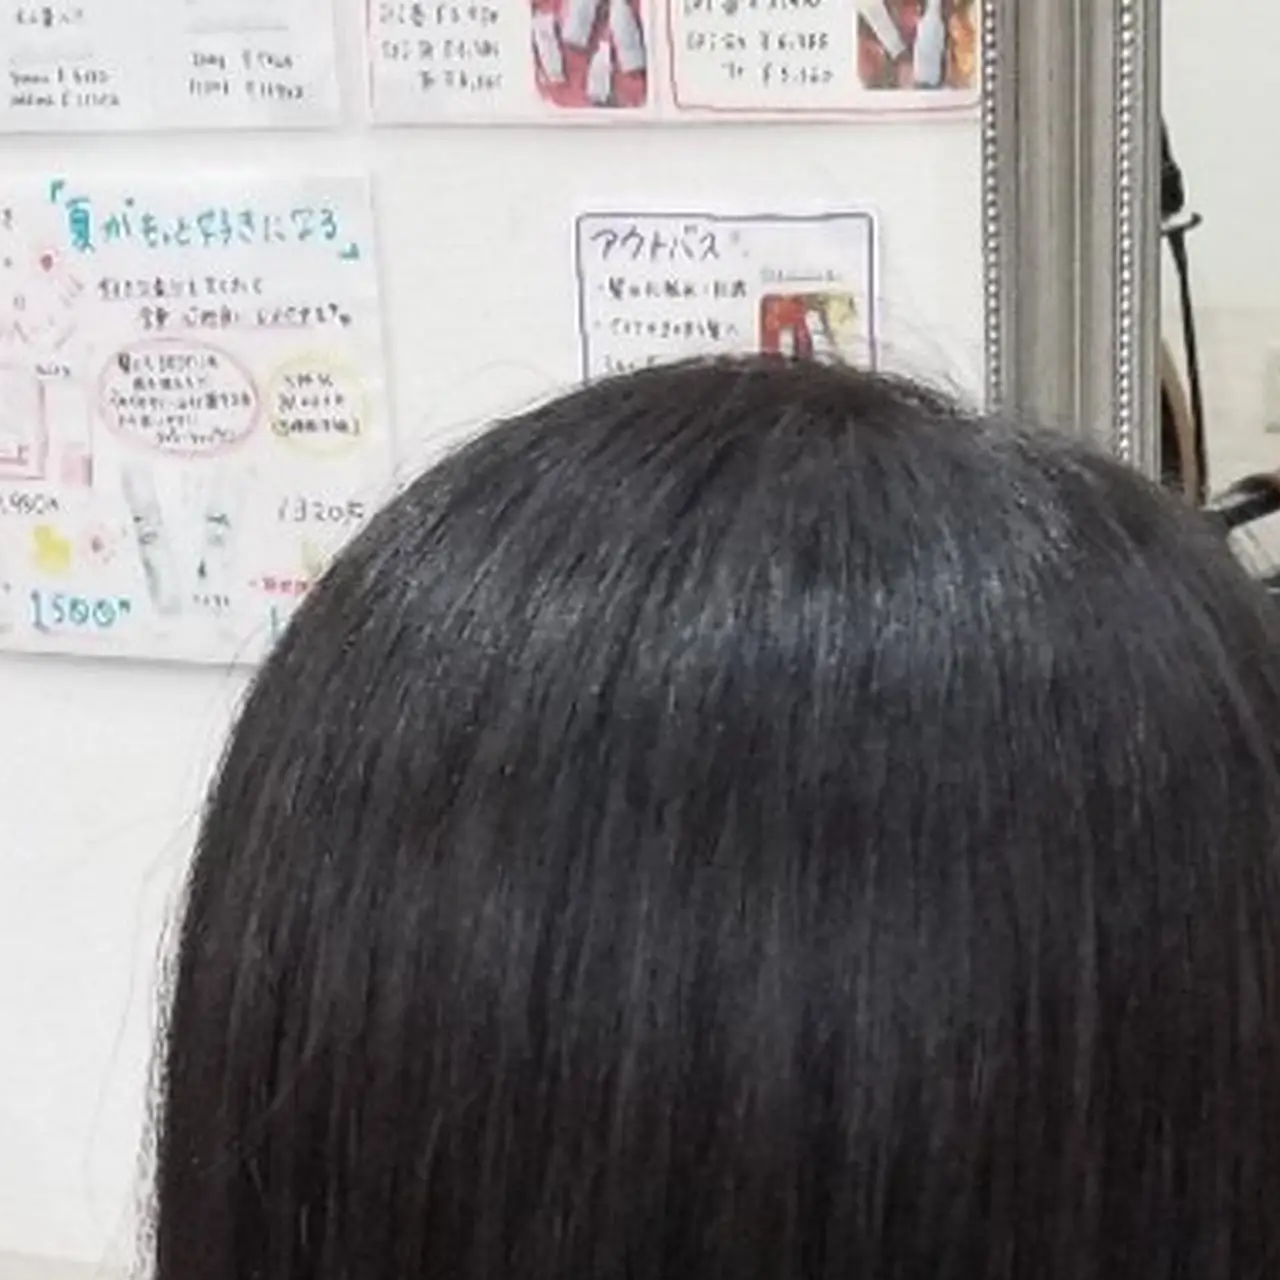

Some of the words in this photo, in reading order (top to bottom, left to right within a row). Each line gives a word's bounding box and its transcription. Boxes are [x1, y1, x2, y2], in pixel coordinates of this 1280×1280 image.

[589, 224, 721, 261] アウトバス
